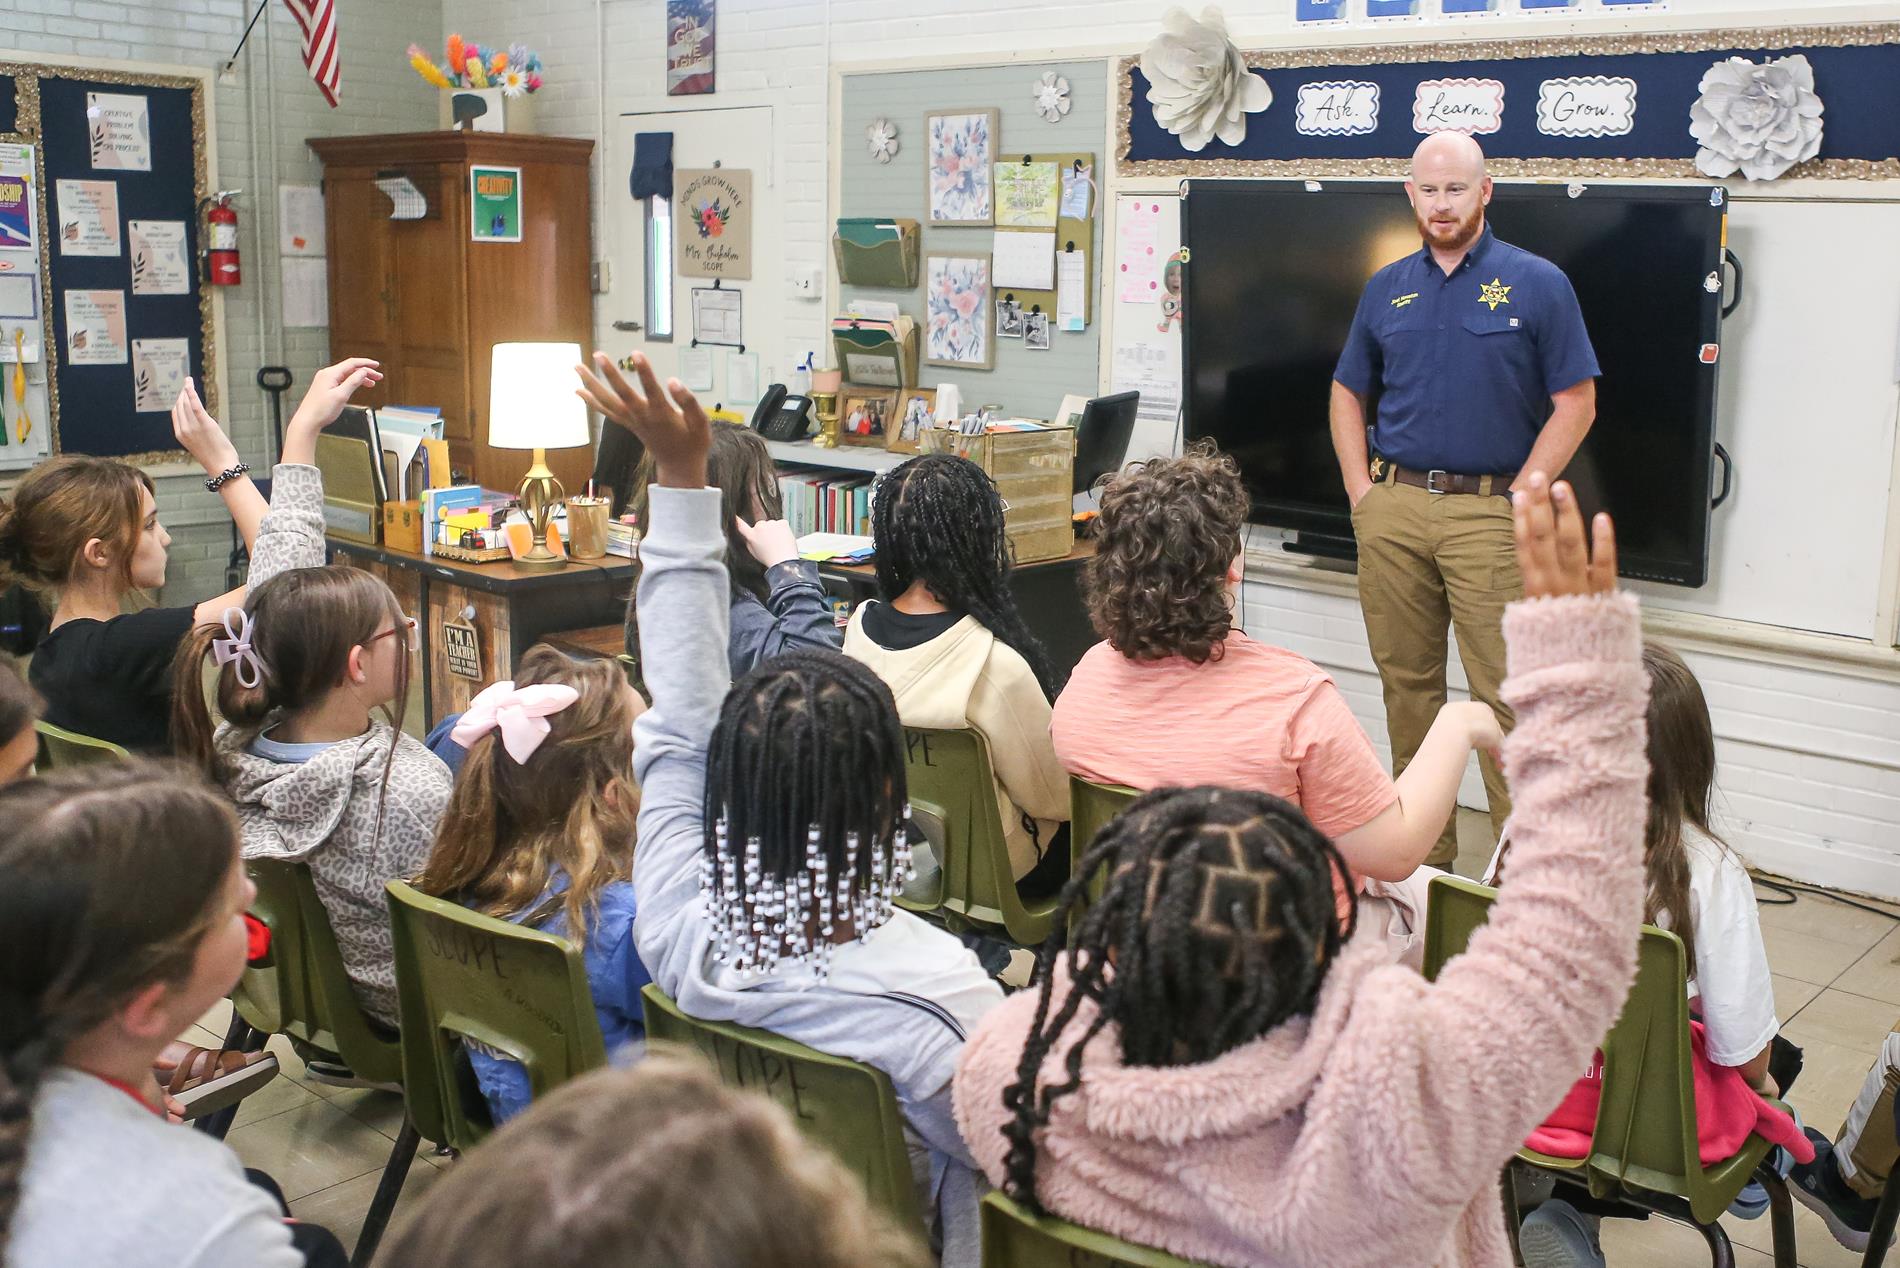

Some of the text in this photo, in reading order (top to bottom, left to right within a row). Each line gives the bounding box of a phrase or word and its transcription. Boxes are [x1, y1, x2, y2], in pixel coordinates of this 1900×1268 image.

[686, 16, 699, 30] IN
[1315, 87, 1615, 123] Ask. Learn. Grow.
[680, 175, 743, 209] MINDS GROW HERE
[703, 261, 724, 272] SCOPE
[467, 632, 474, 647] A
[448, 644, 476, 661] TEACHER
